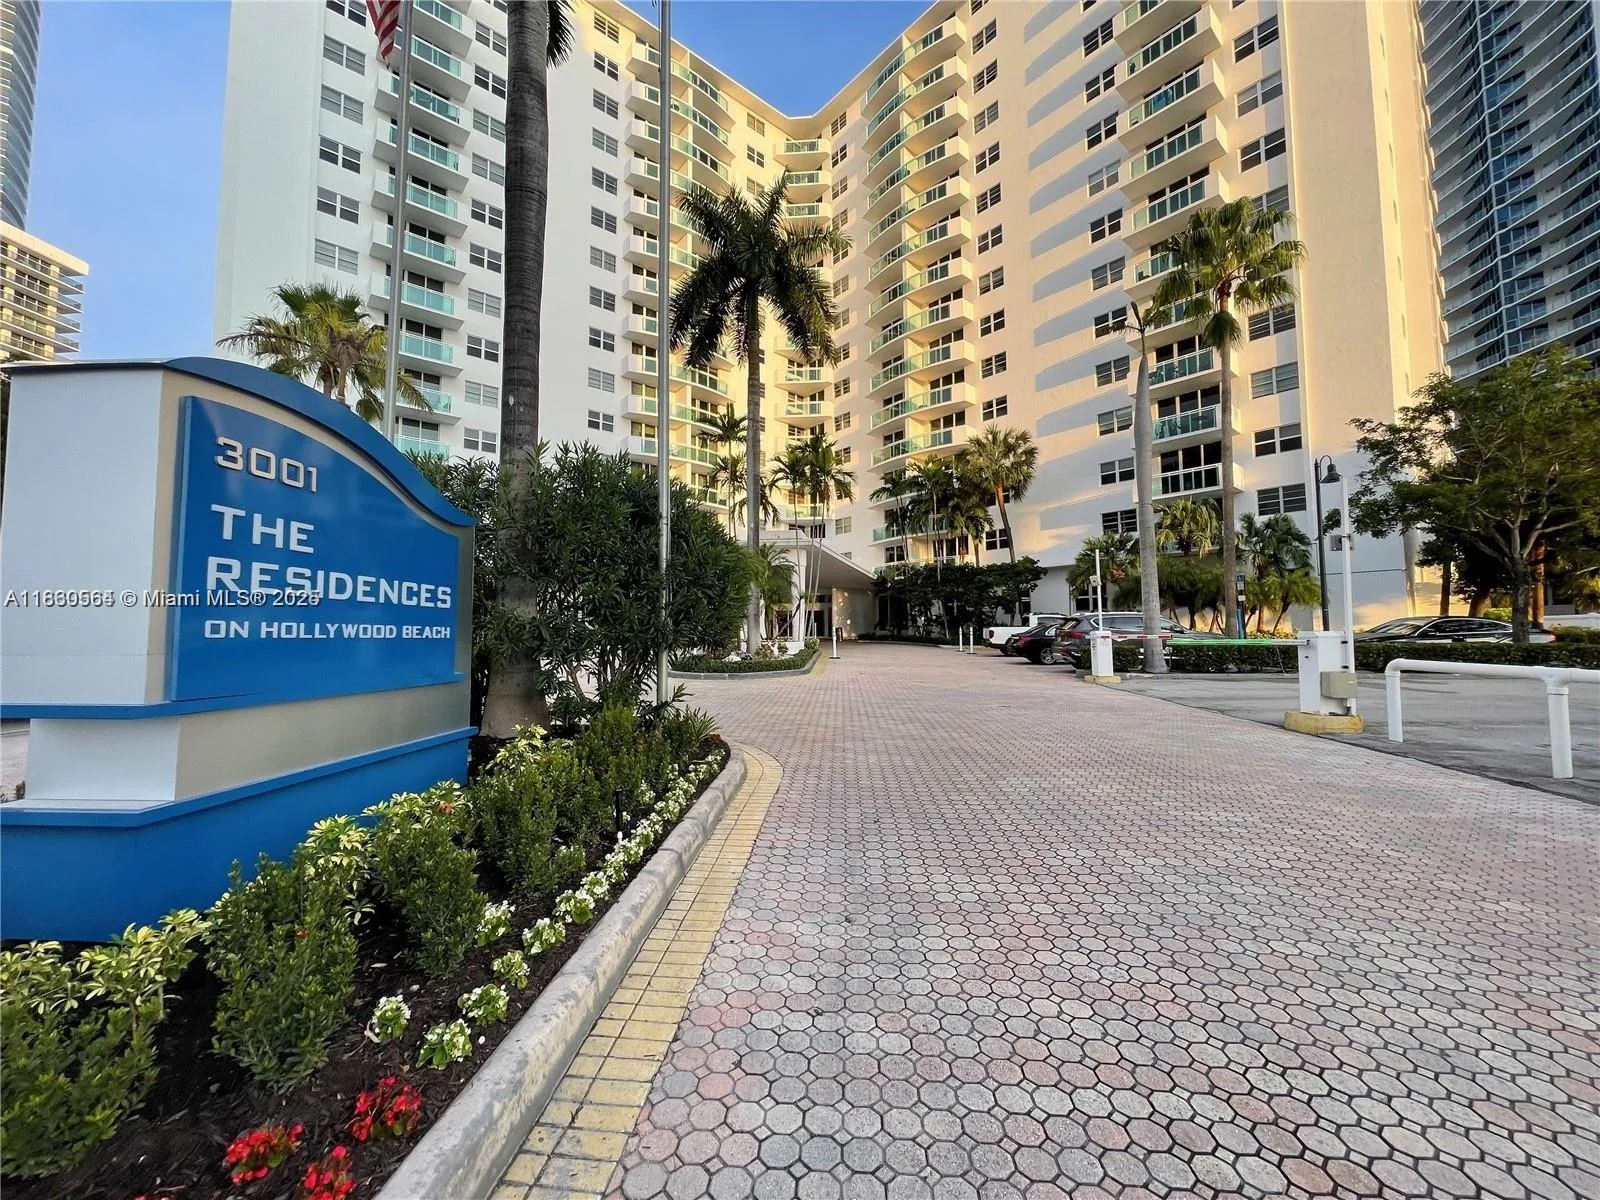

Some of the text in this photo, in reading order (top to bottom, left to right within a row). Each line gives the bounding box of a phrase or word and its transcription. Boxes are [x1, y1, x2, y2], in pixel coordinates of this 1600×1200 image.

[214, 436, 318, 493] 3001
[210, 503, 316, 554] THE
[206, 555, 452, 609] RESIDENCES
[204, 619, 451, 639] ON HOLLYWOOD BEACH
